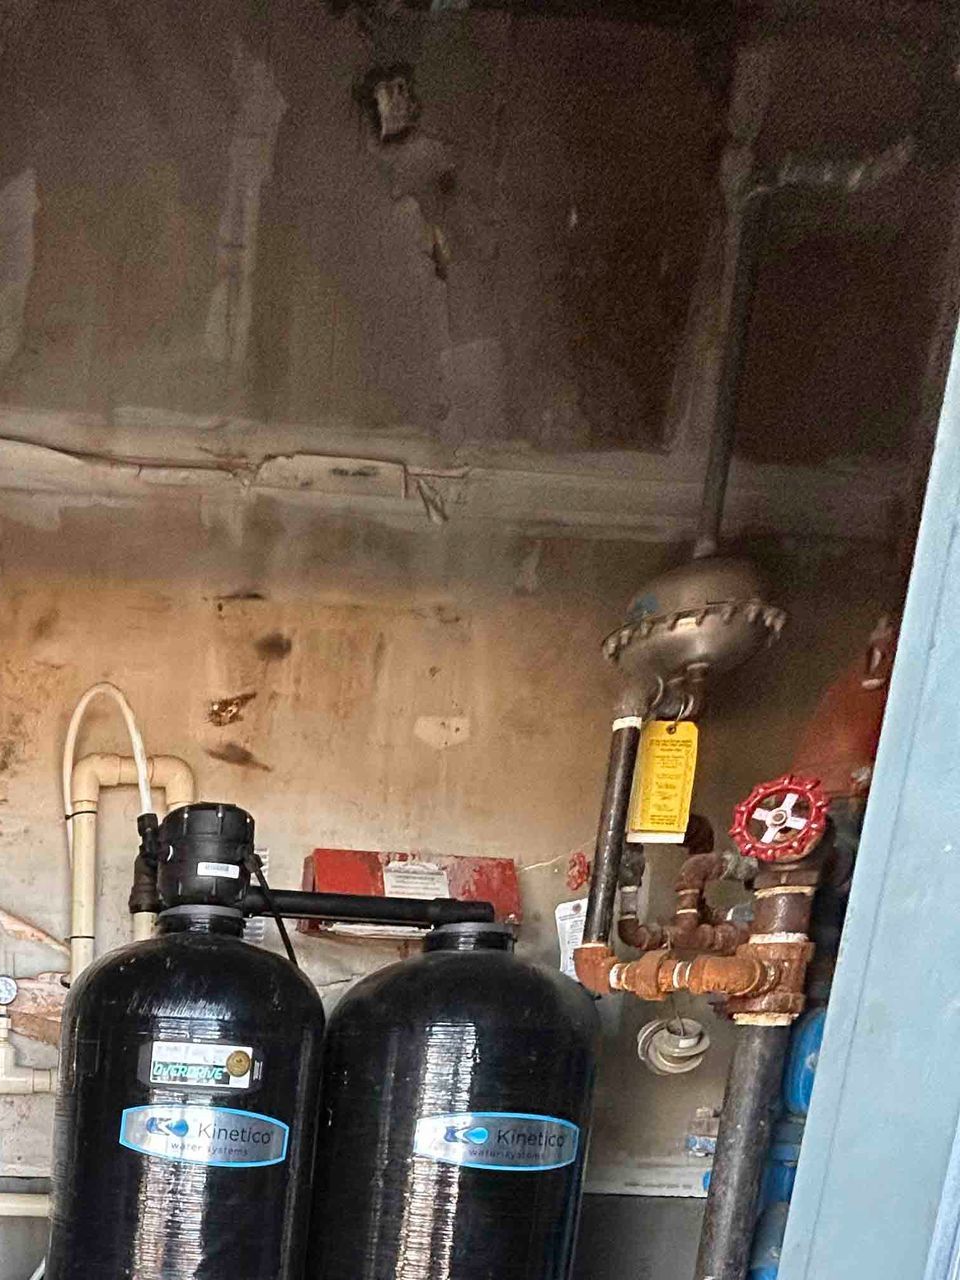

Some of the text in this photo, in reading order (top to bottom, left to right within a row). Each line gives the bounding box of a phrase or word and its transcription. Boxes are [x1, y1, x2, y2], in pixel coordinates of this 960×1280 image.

[152, 1060, 225, 1080] OVERDRIVE
[197, 1122, 272, 1145] Kinetico
[496, 1128, 566, 1148] Kinetico
[207, 1144, 249, 1156] systems
